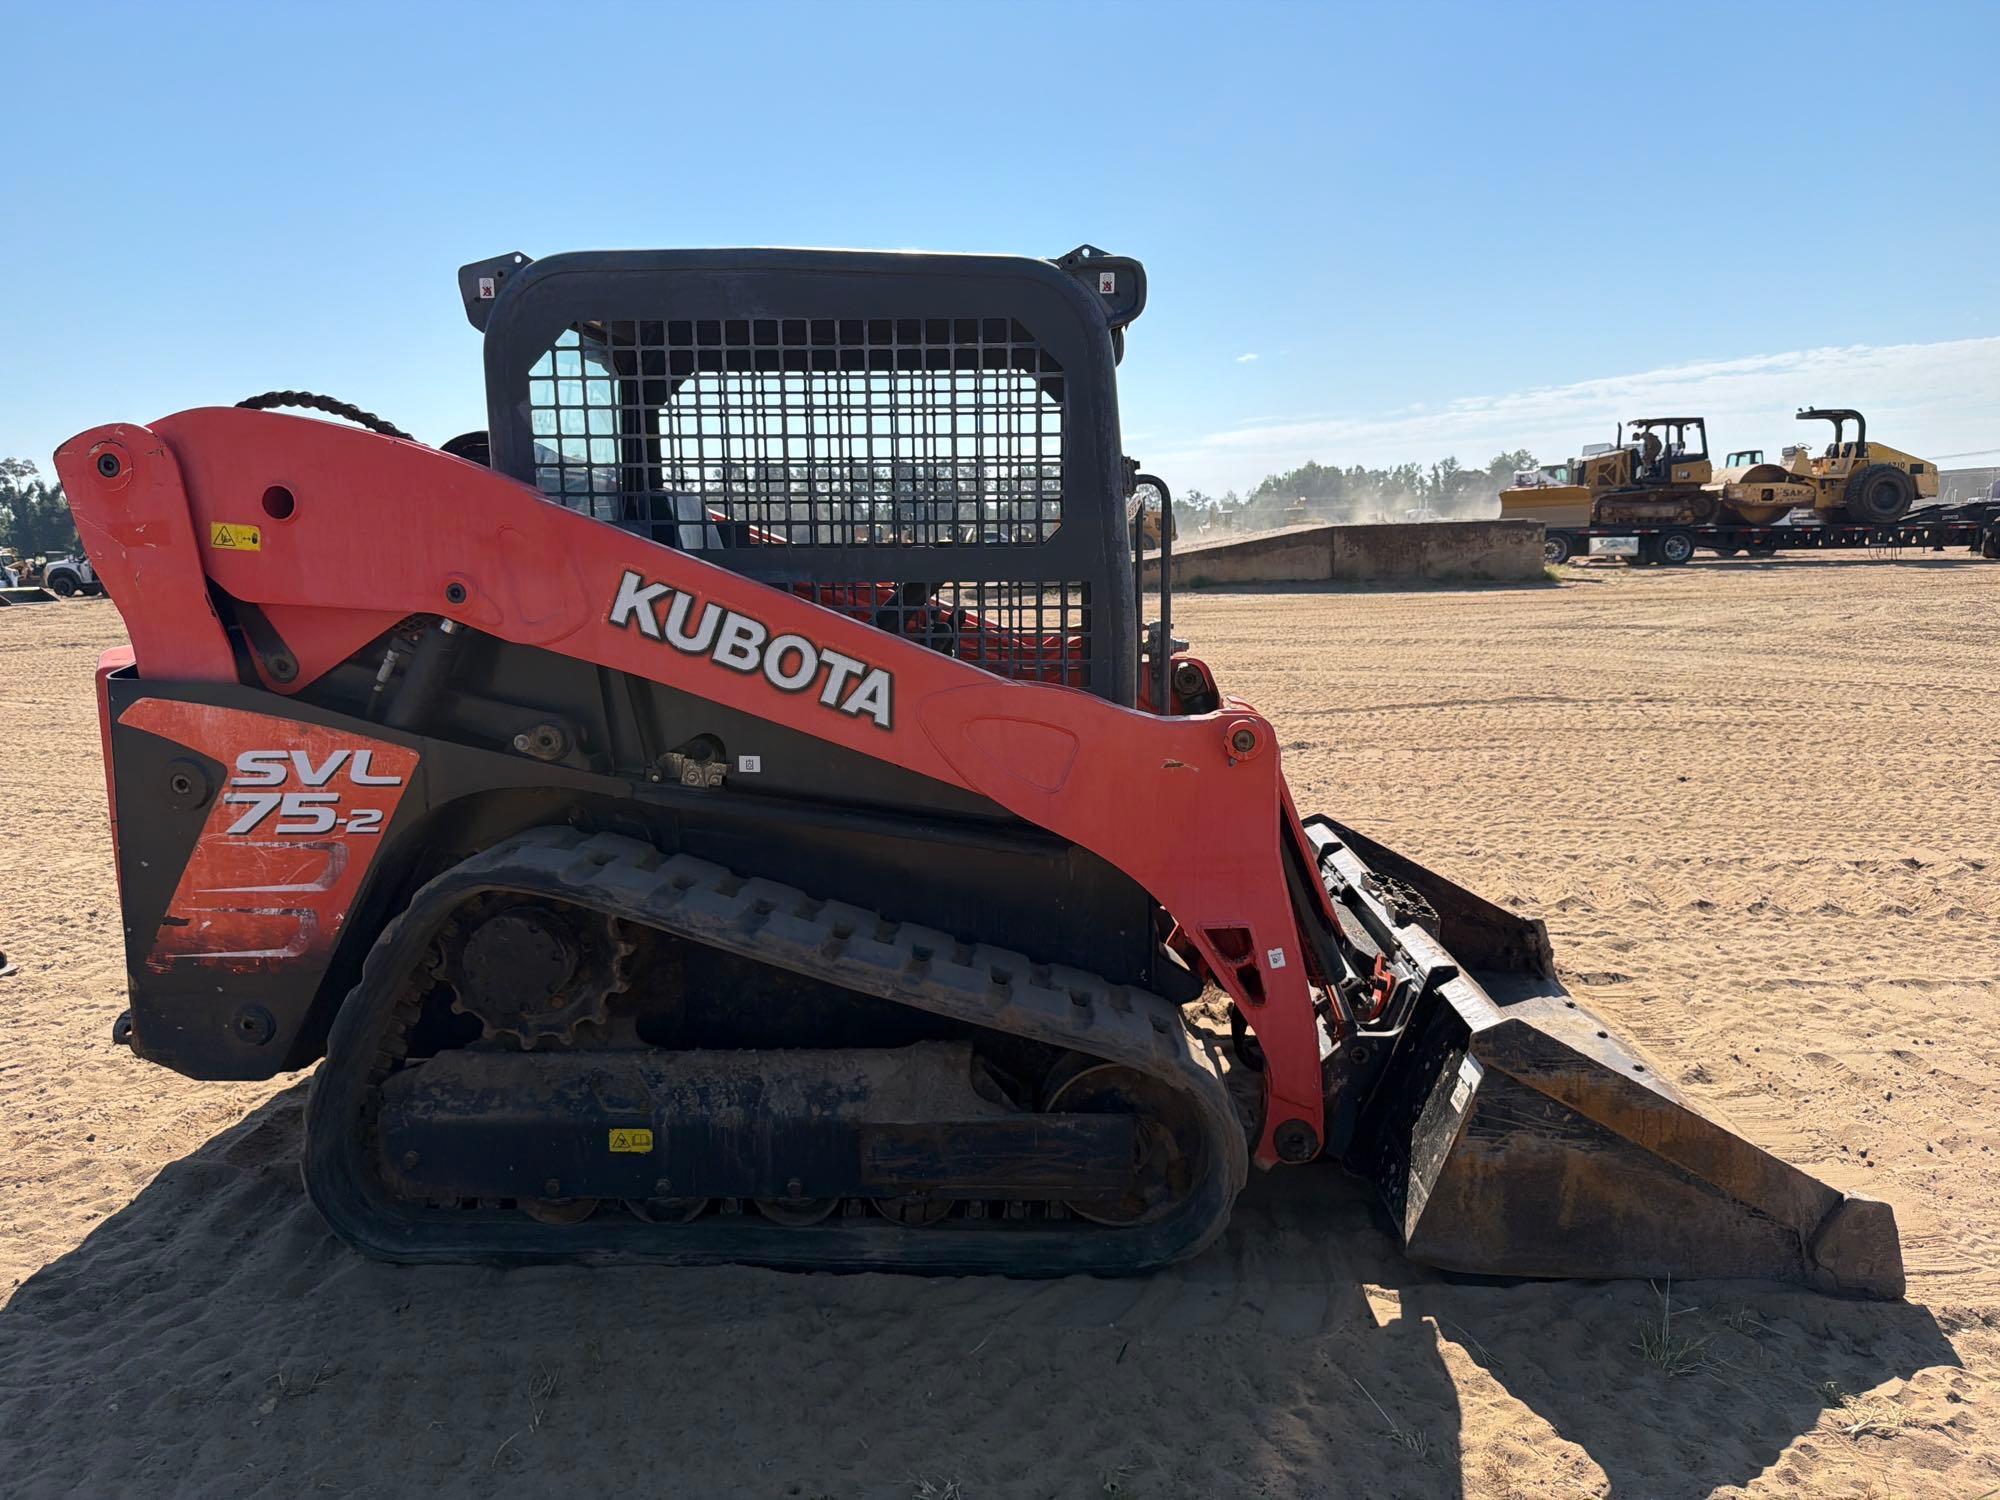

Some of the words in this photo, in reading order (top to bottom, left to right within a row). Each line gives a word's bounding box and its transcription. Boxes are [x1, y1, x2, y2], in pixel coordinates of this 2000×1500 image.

[609, 570, 893, 729] KUBOTA
[230, 750, 401, 785] SVL
[223, 793, 383, 834] 75-2
